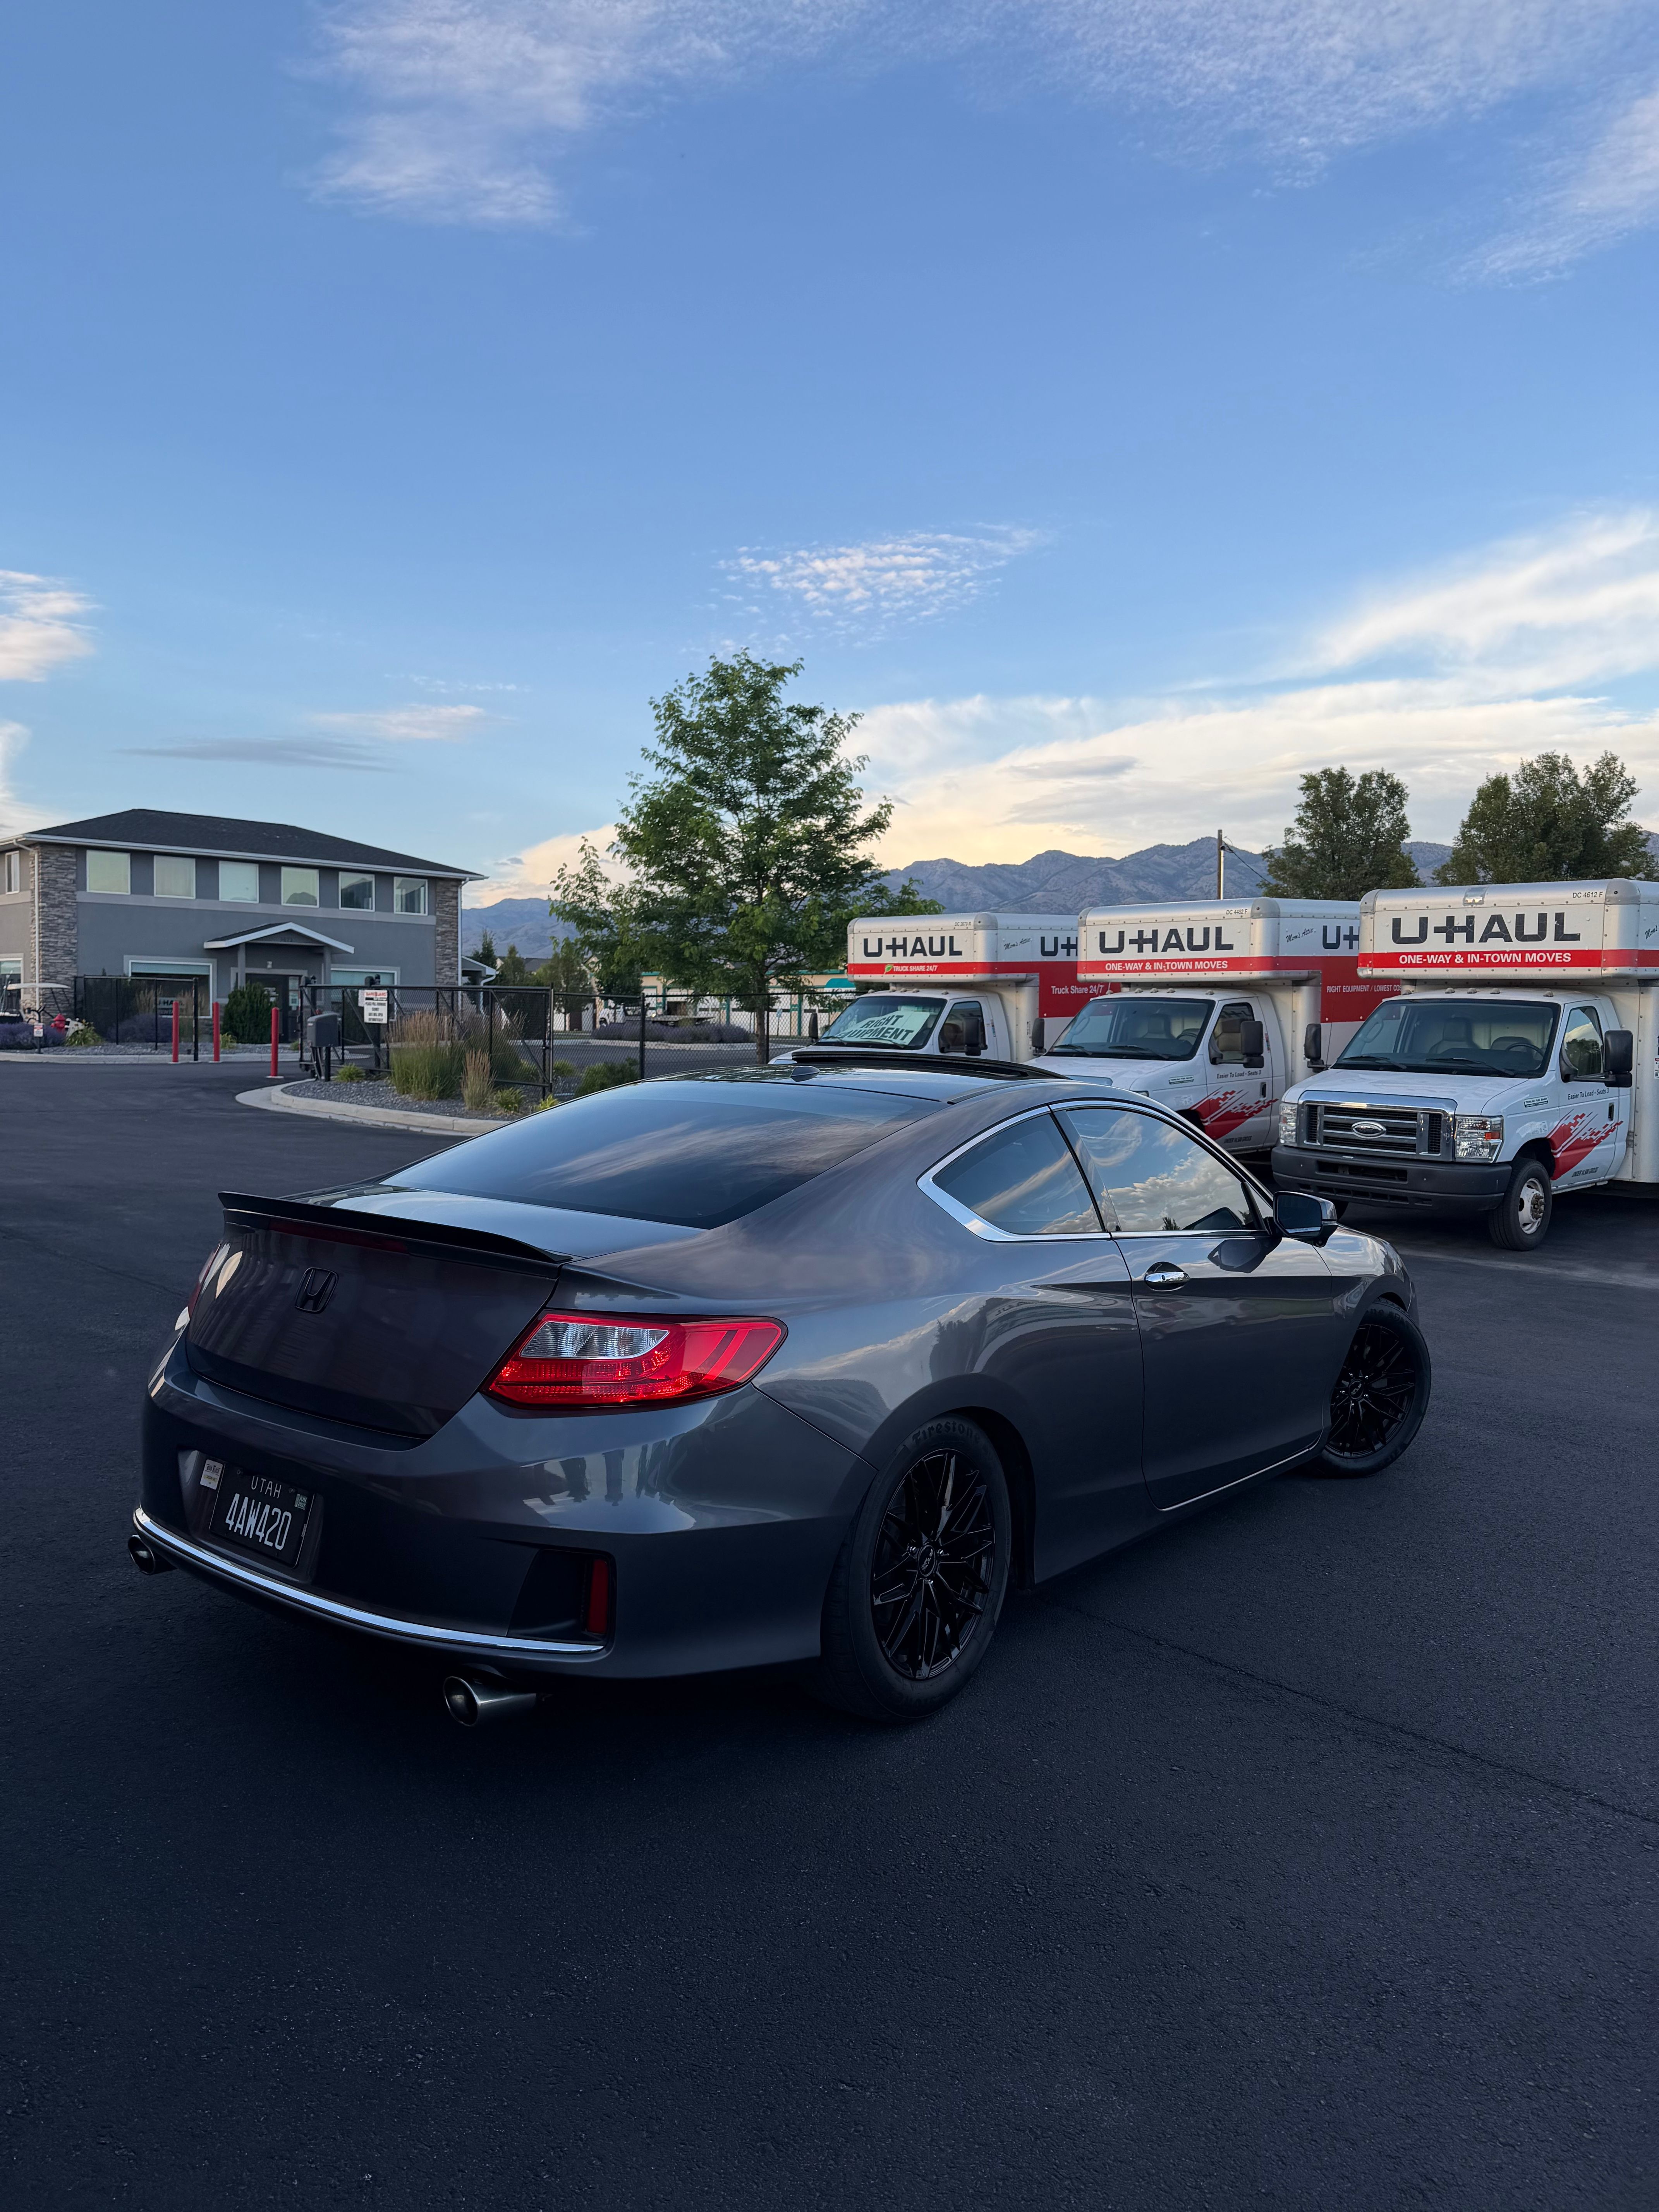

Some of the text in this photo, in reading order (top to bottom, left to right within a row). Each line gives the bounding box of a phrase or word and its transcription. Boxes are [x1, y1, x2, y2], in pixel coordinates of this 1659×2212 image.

[1392, 912, 1580, 944] U-HAUL
[863, 936, 962, 957] U-HAUL
[1099, 926, 1234, 954] U-HAUL
[1105, 963, 1143, 971] ONE-WAY
[1154, 962, 1193, 971] IN-TOWN
[1195, 961, 1228, 969] MOVES
[1400, 953, 1571, 963] ONE-WAY & IN-TOWN MOVES
[1051, 984, 1103, 994] Truck Share 24/7
[860, 1015, 904, 1029] RIGHT
[912, 1420, 980, 1445] Firestone
[251, 1475, 282, 1499] UTAH
[225, 1493, 292, 1550] 4AW420
